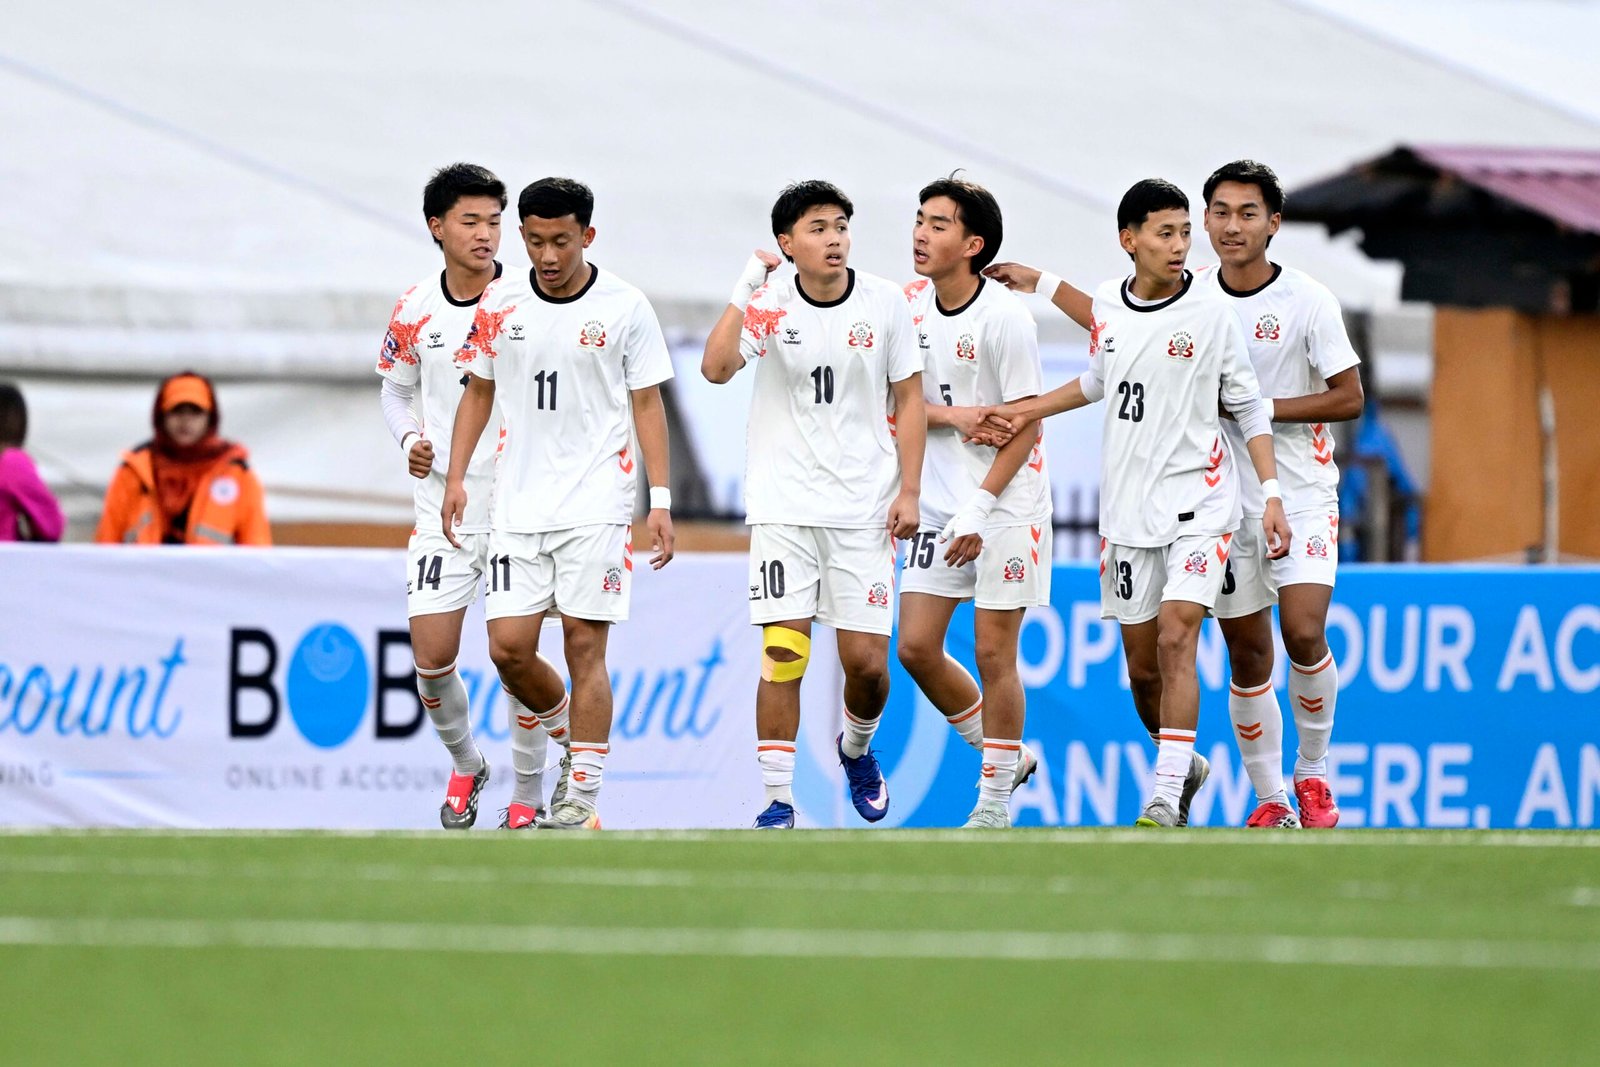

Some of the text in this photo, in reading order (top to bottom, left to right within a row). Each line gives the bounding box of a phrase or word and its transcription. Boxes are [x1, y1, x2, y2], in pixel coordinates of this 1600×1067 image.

[534, 370, 558, 411] 11
[810, 365, 835, 404] 10
[1118, 381, 1145, 423] 23
[909, 532, 936, 569] 15
[417, 555, 443, 591] 14
[490, 553, 511, 592] 11
[760, 560, 785, 599] 10
[1013, 601, 1227, 692] OPN
[227, 764, 448, 791] ONLINE ACCOUN
